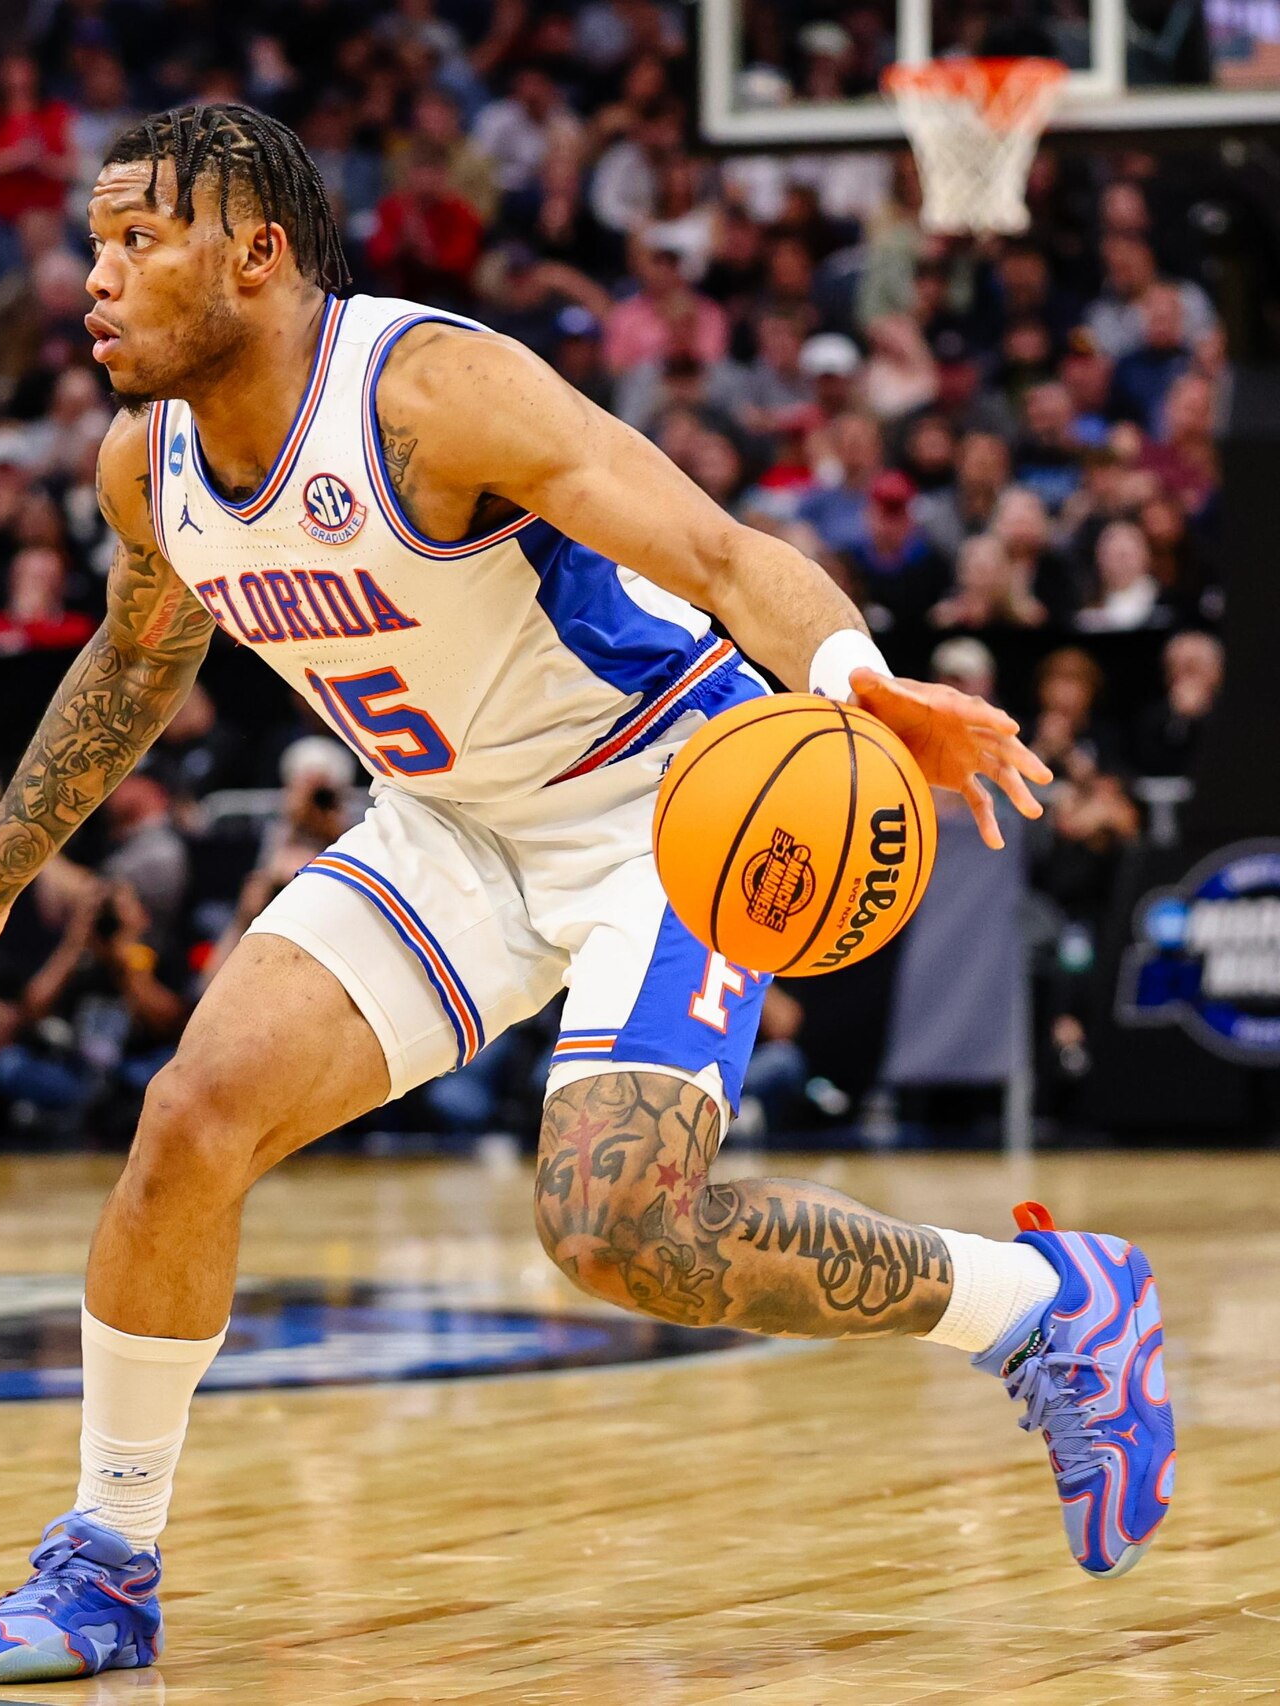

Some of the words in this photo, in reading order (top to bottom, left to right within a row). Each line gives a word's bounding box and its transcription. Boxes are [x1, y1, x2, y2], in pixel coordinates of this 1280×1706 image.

[306, 476, 352, 527] SEC
[310, 516, 362, 544] GRADUATE
[194, 567, 423, 646] FLORIDA
[304, 665, 458, 778] 15
[752, 857, 788, 926] MADNESS
[773, 857, 805, 911] MARCH
[809, 803, 907, 969] Wilson
[848, 877, 862, 903] EVO
[836, 905, 852, 930] NXT
[754, 1196, 951, 1316] MISSISSIPP
